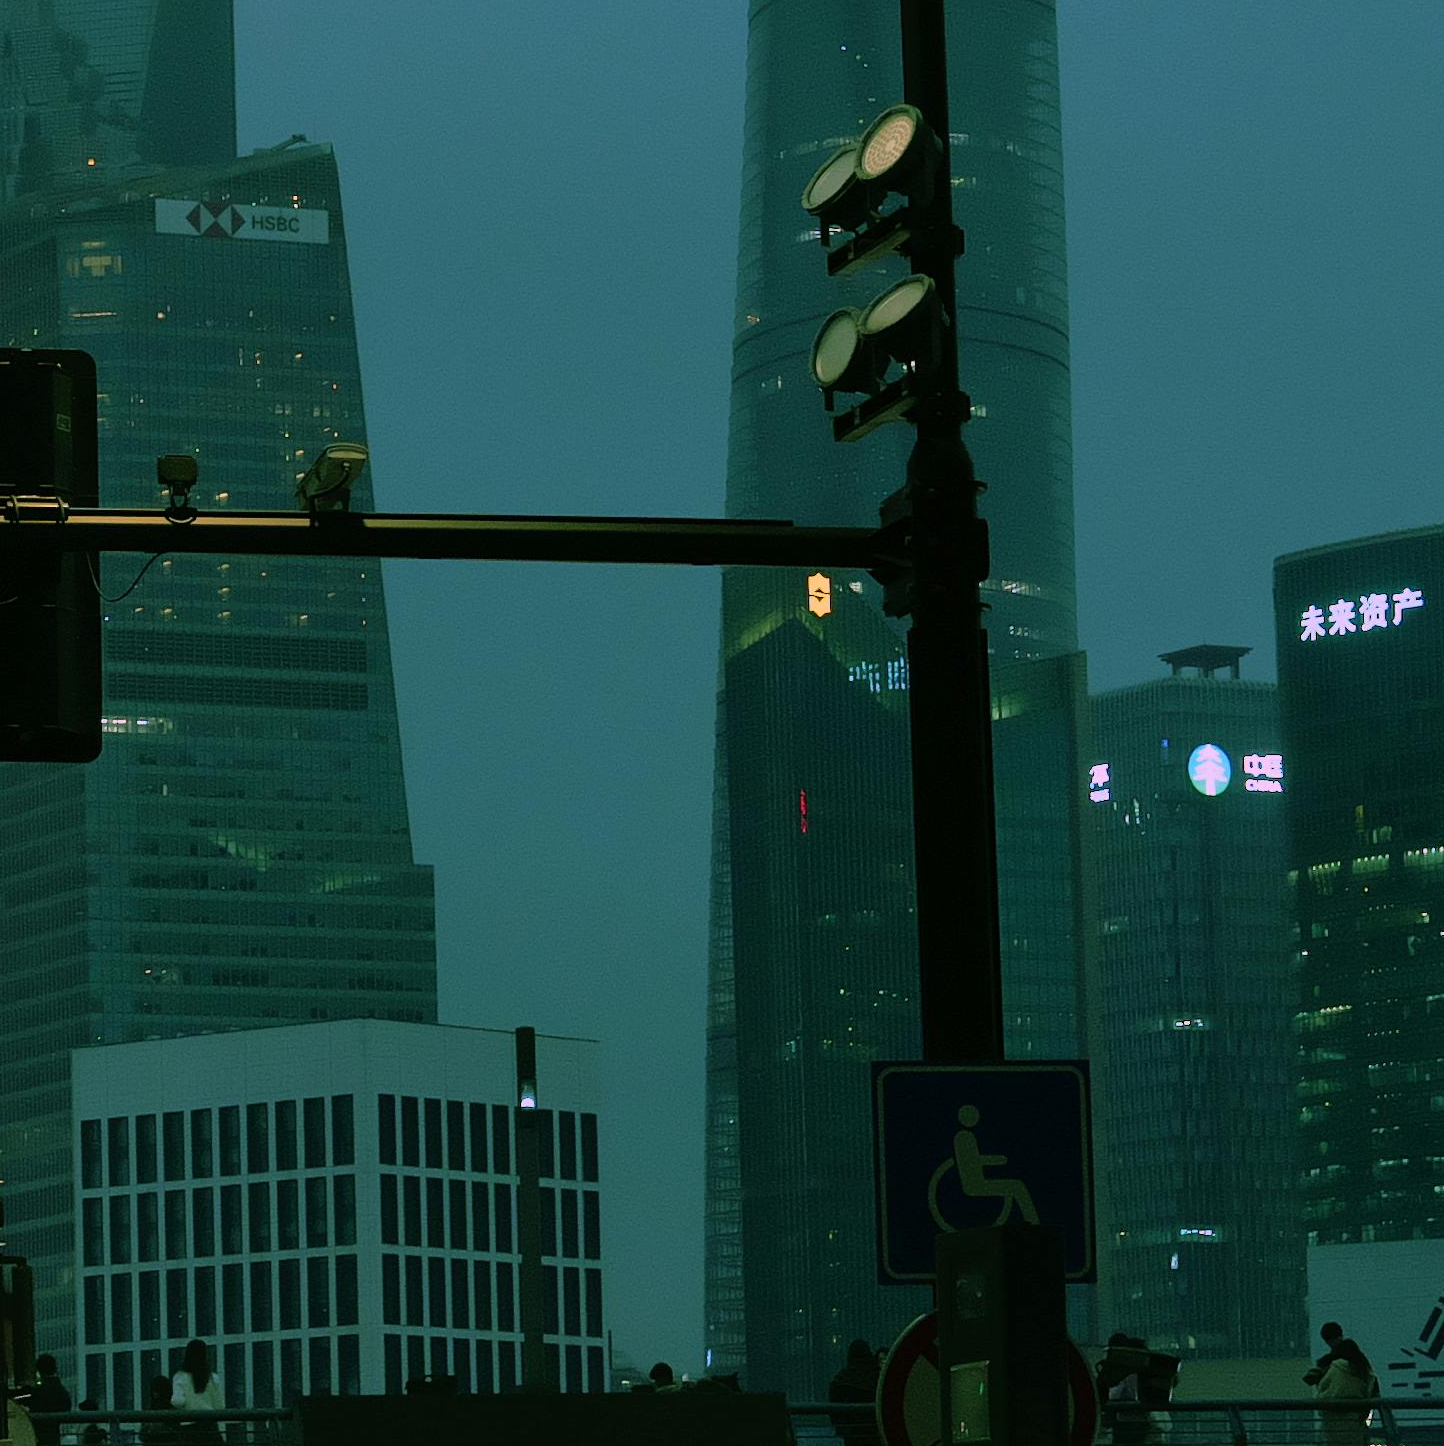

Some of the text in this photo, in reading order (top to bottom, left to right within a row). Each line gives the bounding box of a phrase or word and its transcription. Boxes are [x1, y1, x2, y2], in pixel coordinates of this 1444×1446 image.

[251, 215, 301, 233] HSBC
[1299, 587, 1424, 642] 未来资产
